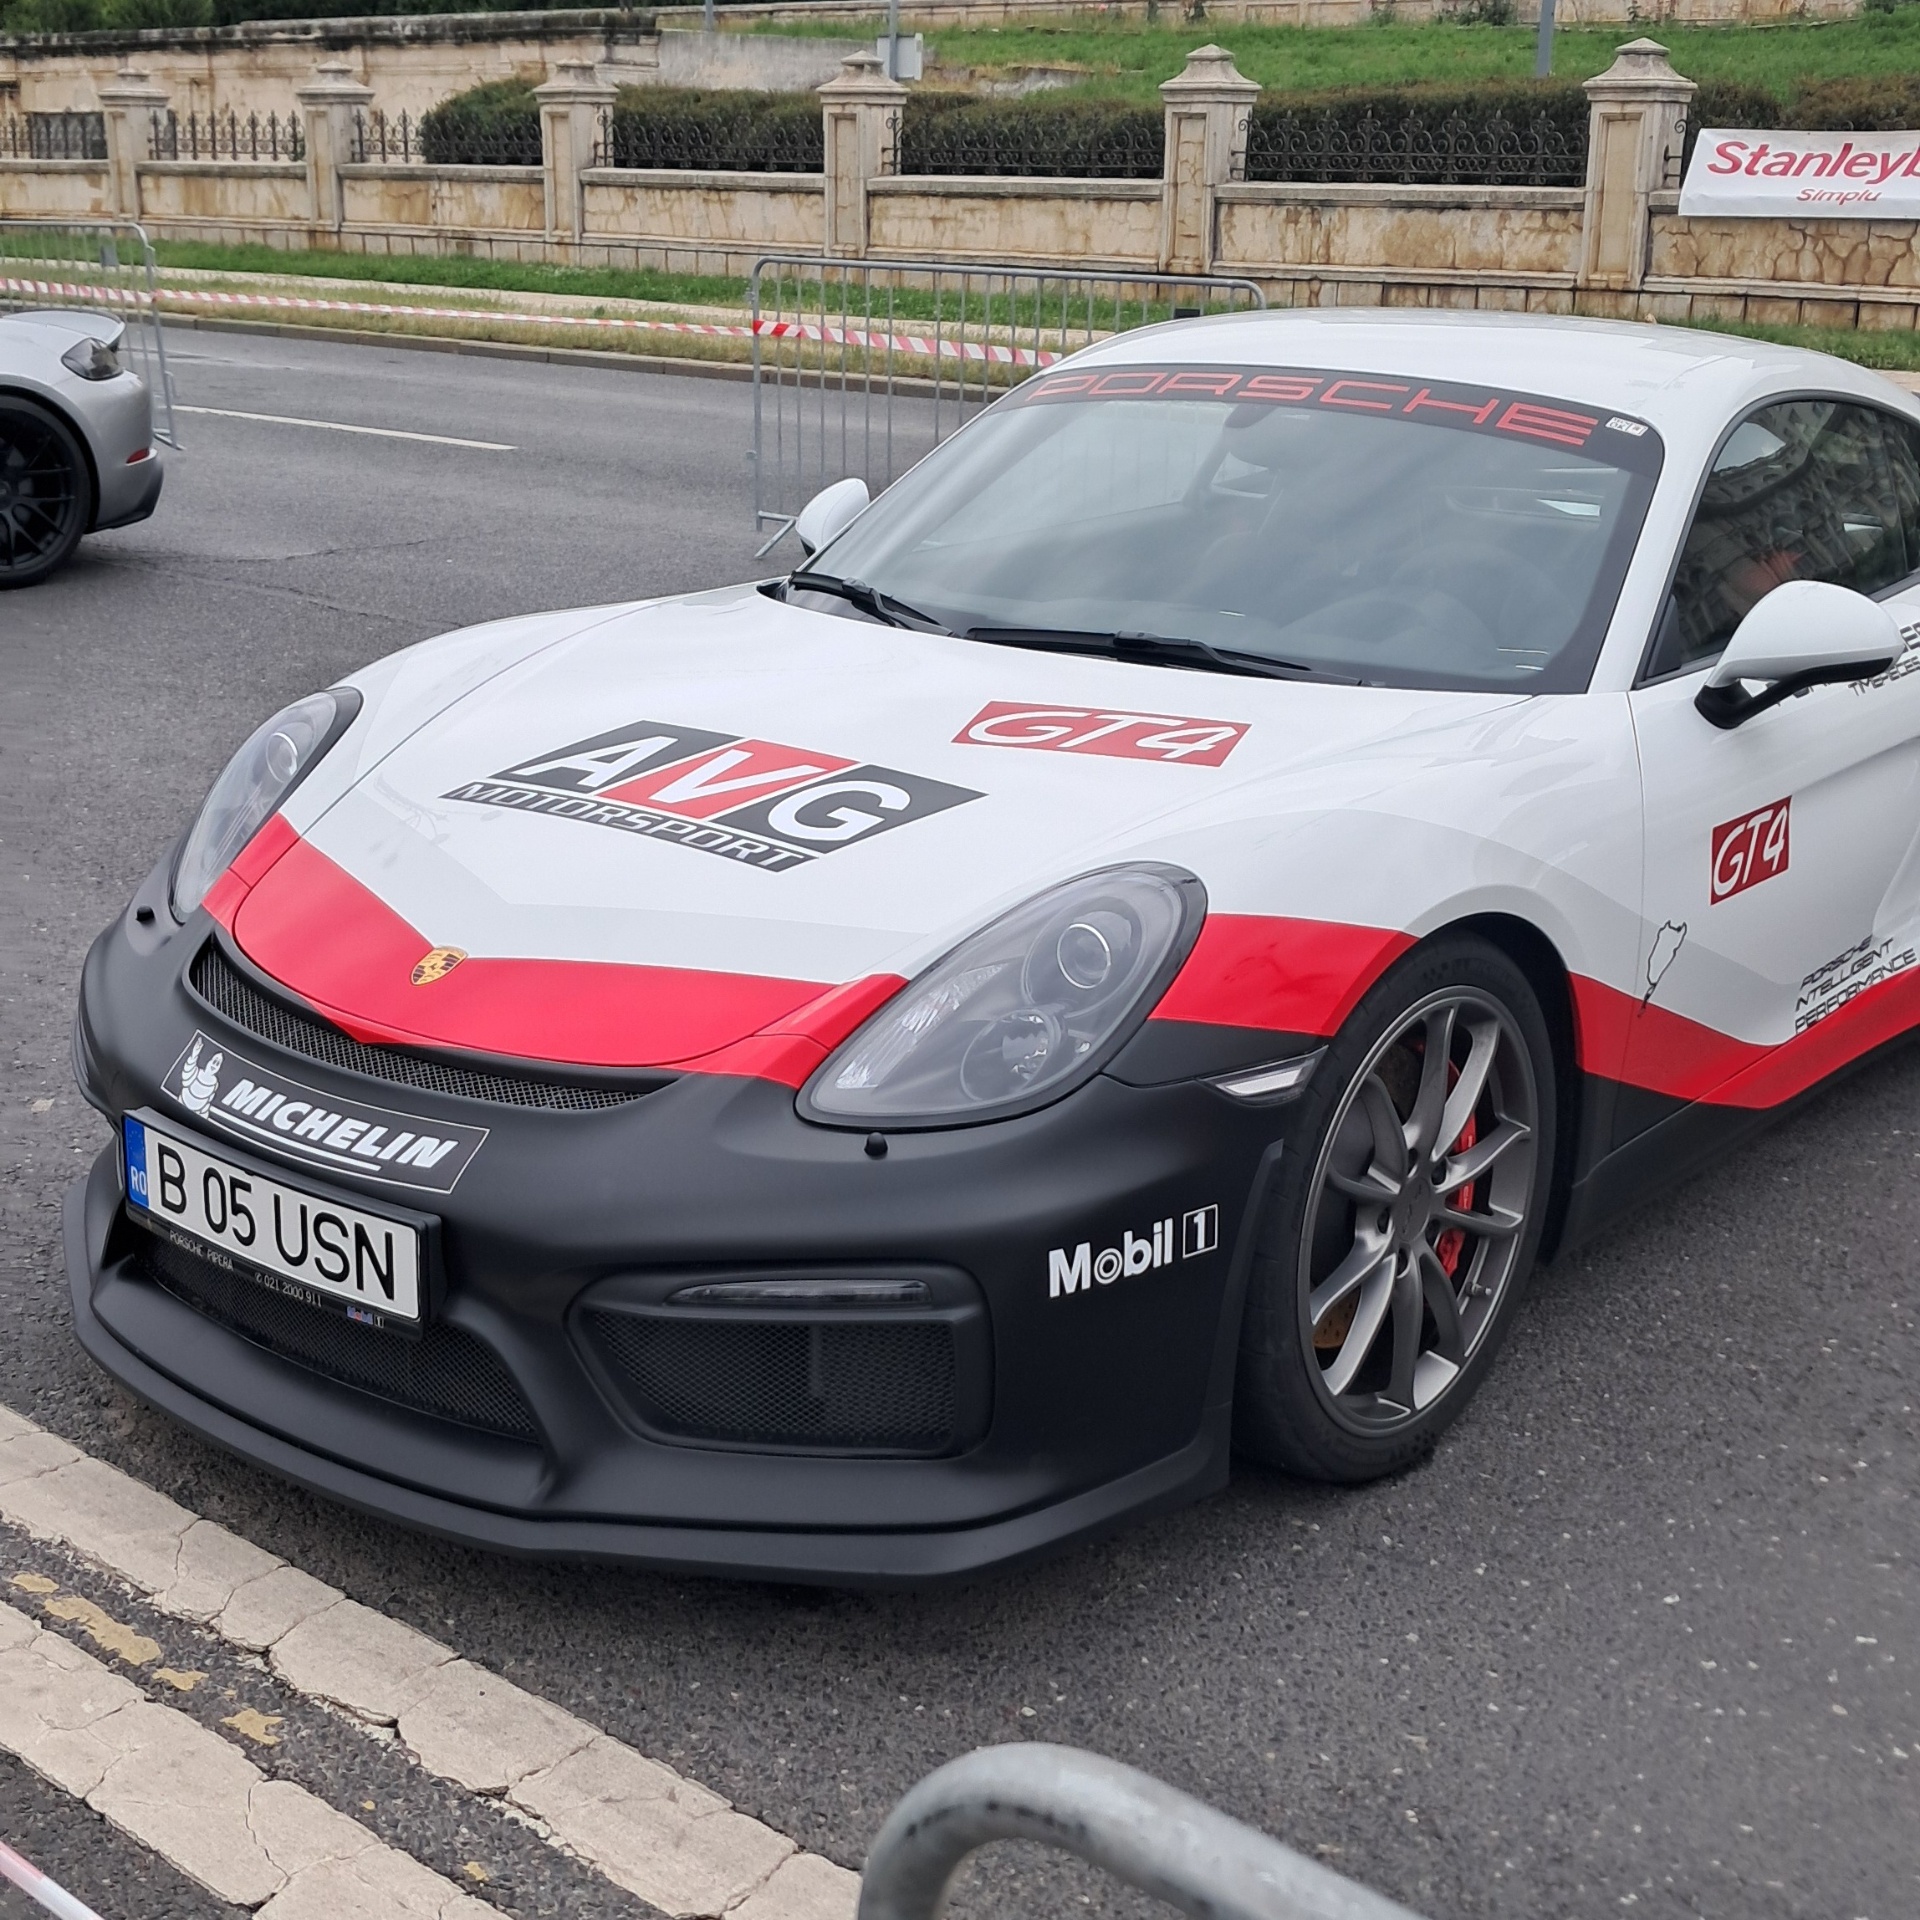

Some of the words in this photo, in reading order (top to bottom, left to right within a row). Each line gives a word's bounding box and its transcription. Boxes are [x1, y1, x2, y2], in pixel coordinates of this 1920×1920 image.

[1025, 372, 1599, 446] PORSCHE
[967, 710, 1239, 759] GT4
[451, 783, 804, 867] MOTORSPORT
[510, 735, 911, 841] AVG
[1713, 805, 1788, 896] GT4
[1795, 947, 1917, 1034] PERFORMANCE
[1800, 934, 1873, 990] PORSCHE
[221, 1078, 458, 1168] MICHELIN
[130, 1165, 147, 1196] RO
[157, 1142, 187, 1214] B
[203, 1167, 256, 1247] 05
[274, 1193, 394, 1301] USN
[170, 1229, 204, 1257] PORSCHE
[1048, 1217, 1174, 1299] Mobil
[264, 1275, 280, 1291] 021
[282, 1281, 304, 1300] 2000
[305, 1290, 322, 1308] 911
